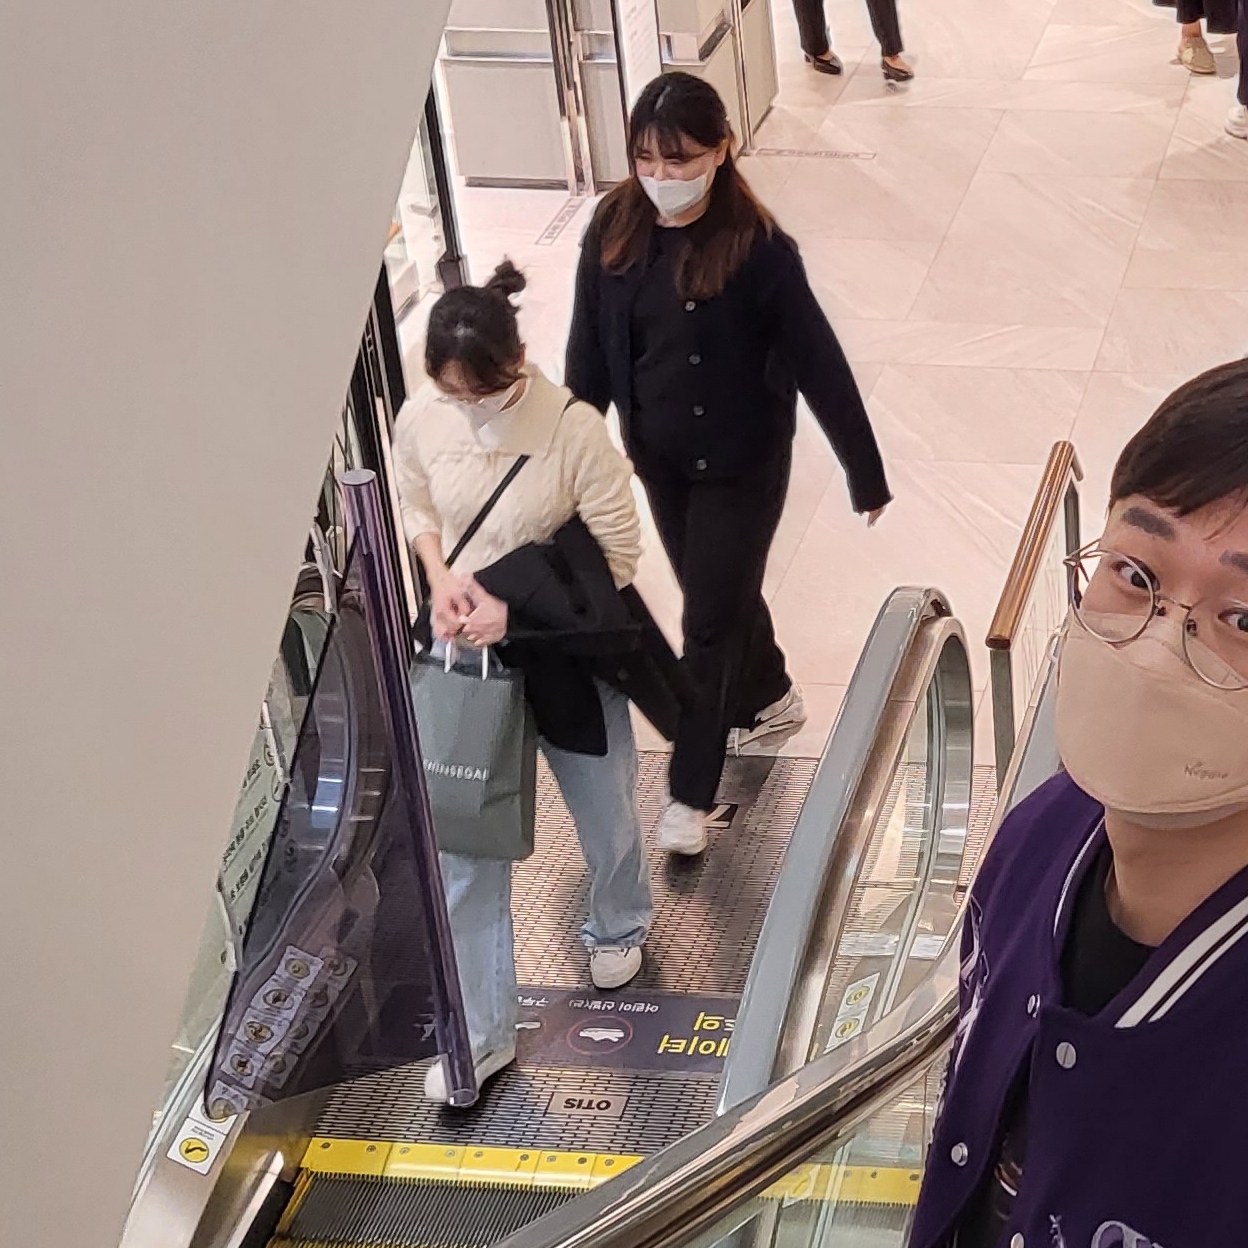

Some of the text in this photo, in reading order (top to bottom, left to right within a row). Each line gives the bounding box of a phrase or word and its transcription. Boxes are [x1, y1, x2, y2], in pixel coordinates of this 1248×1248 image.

[517, 996, 550, 1007] 구두
[618, 1001, 660, 1014] 어린이
[563, 1097, 611, 1111] OTIS
